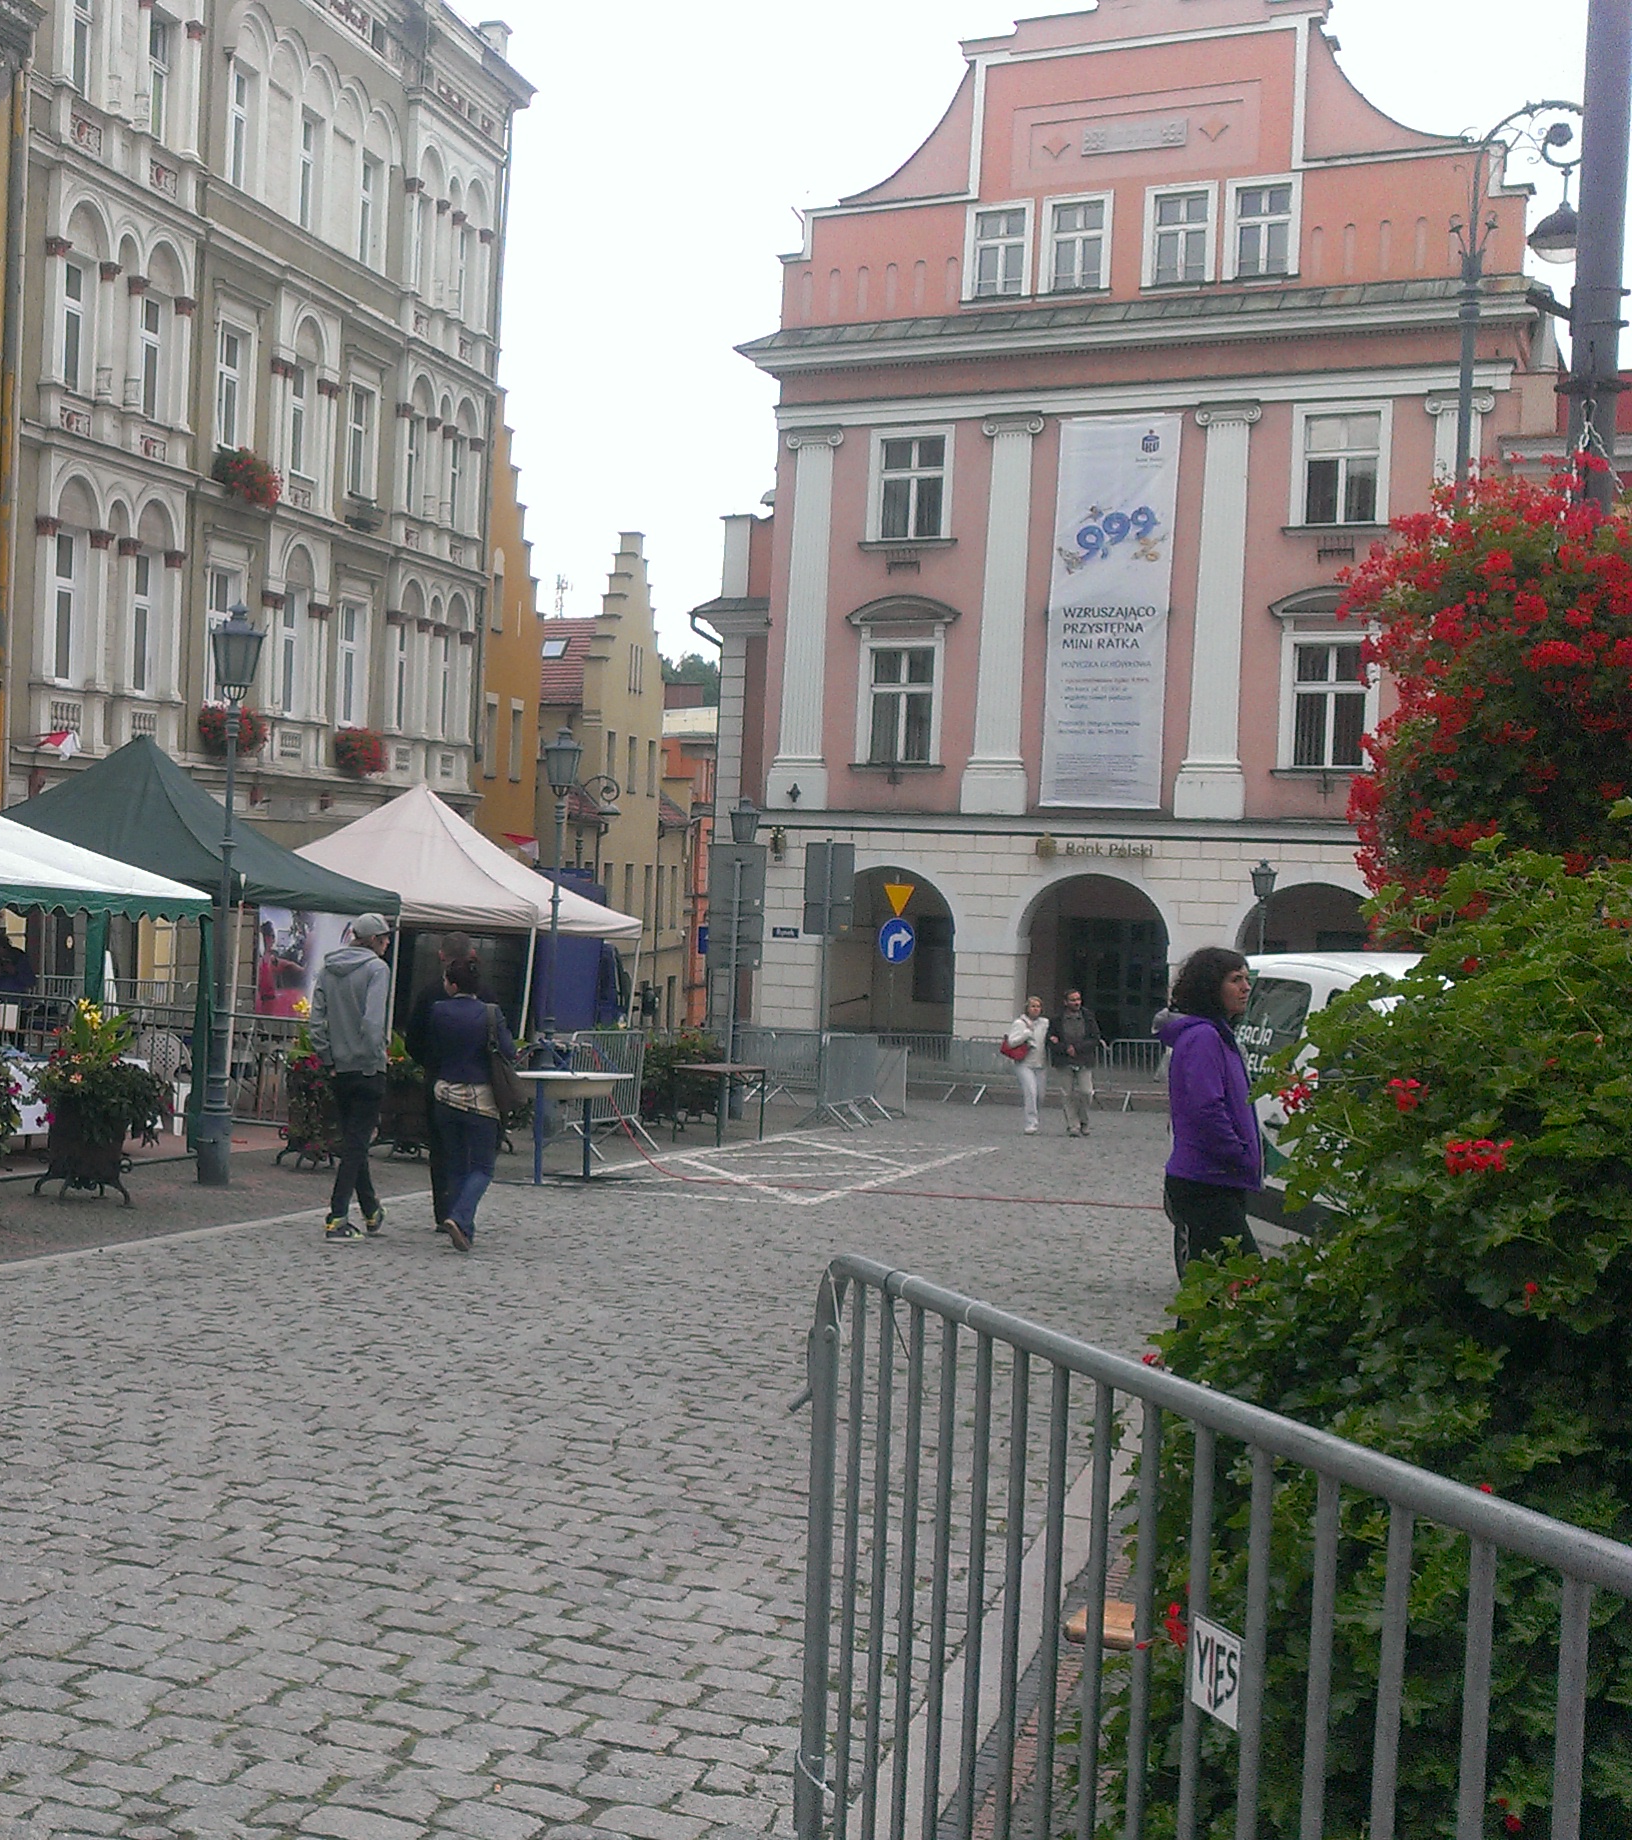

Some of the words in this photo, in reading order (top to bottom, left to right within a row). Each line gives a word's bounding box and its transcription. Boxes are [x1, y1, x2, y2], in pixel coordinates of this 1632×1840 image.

[1063, 605, 1156, 620] WZRUSZAJĄCO
[1063, 623, 1143, 637] PRZYSTĘPNA
[1062, 638, 1093, 649] MINI
[1097, 638, 1140, 649] RATKA
[1065, 842, 1103, 856] Bank
[1109, 843, 1153, 858] Polski
